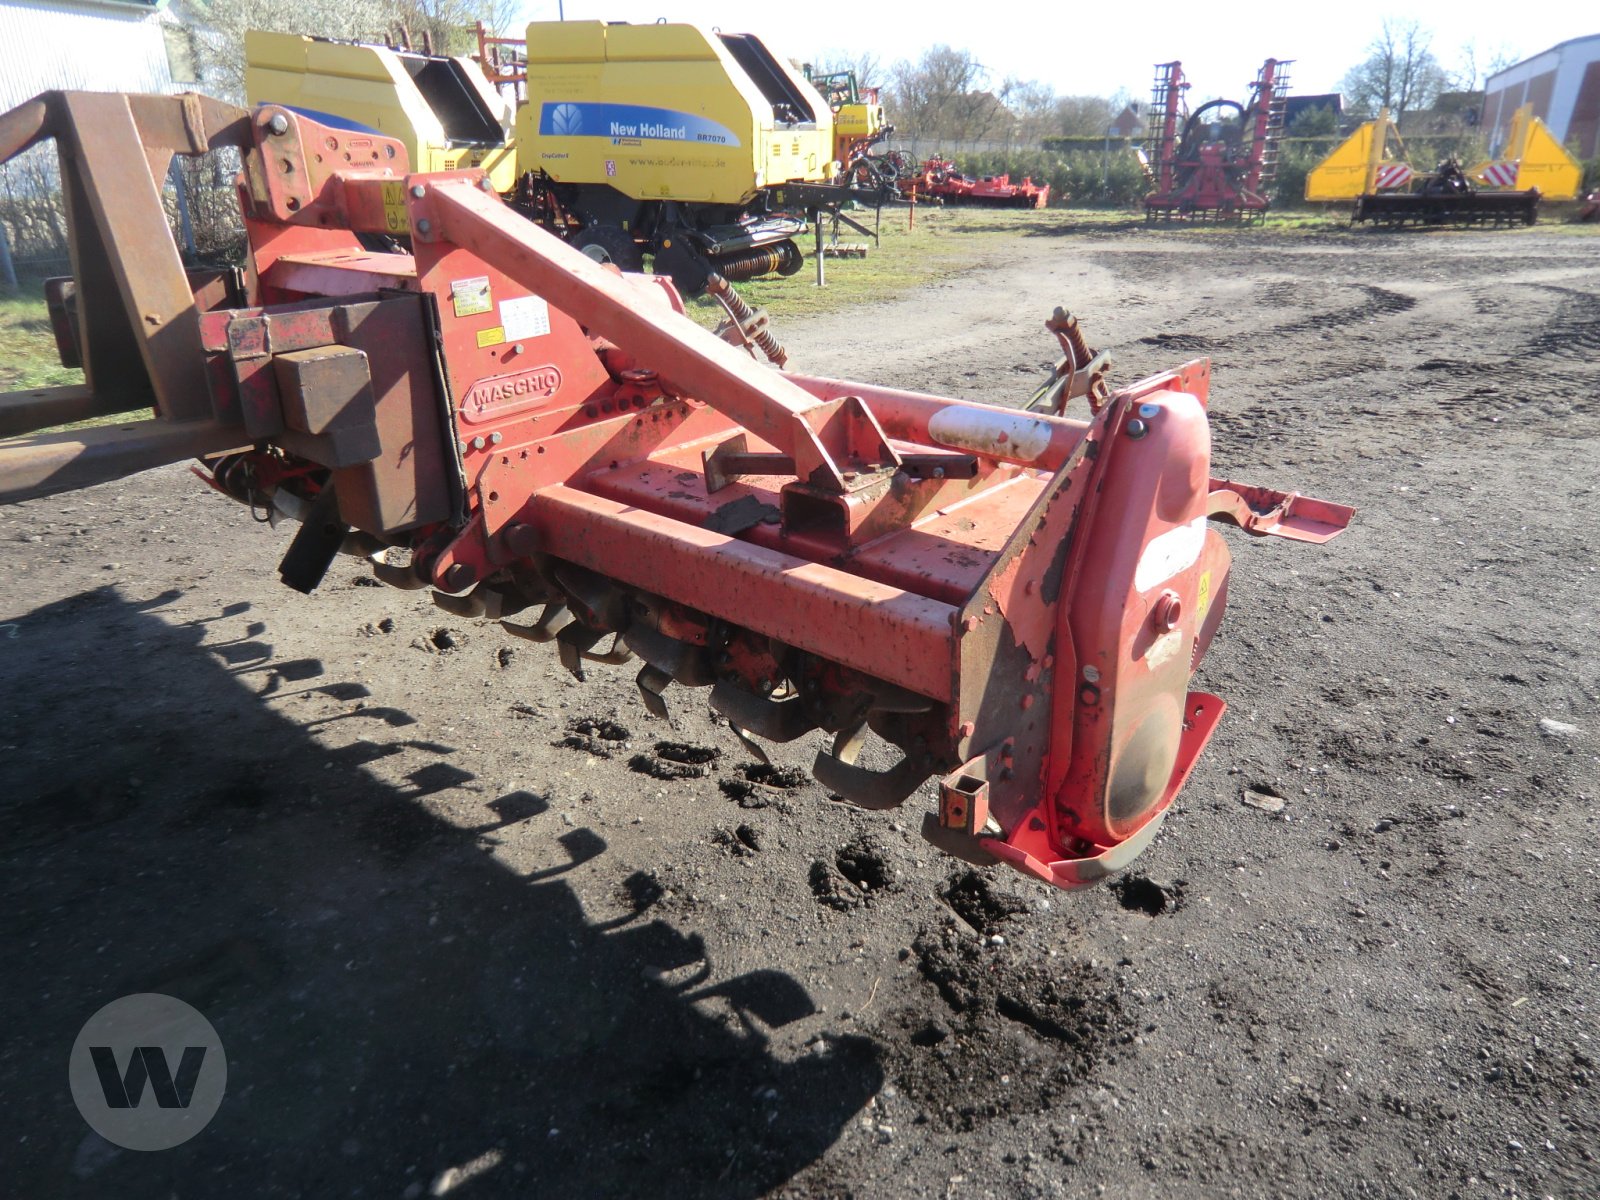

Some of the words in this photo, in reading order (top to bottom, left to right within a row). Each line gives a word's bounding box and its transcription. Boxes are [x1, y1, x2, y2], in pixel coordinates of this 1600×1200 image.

[610, 121, 637, 136] New
[640, 123, 686, 139] Holland
[697, 133, 726, 144] BR7070
[474, 371, 557, 407] MASCHIO
